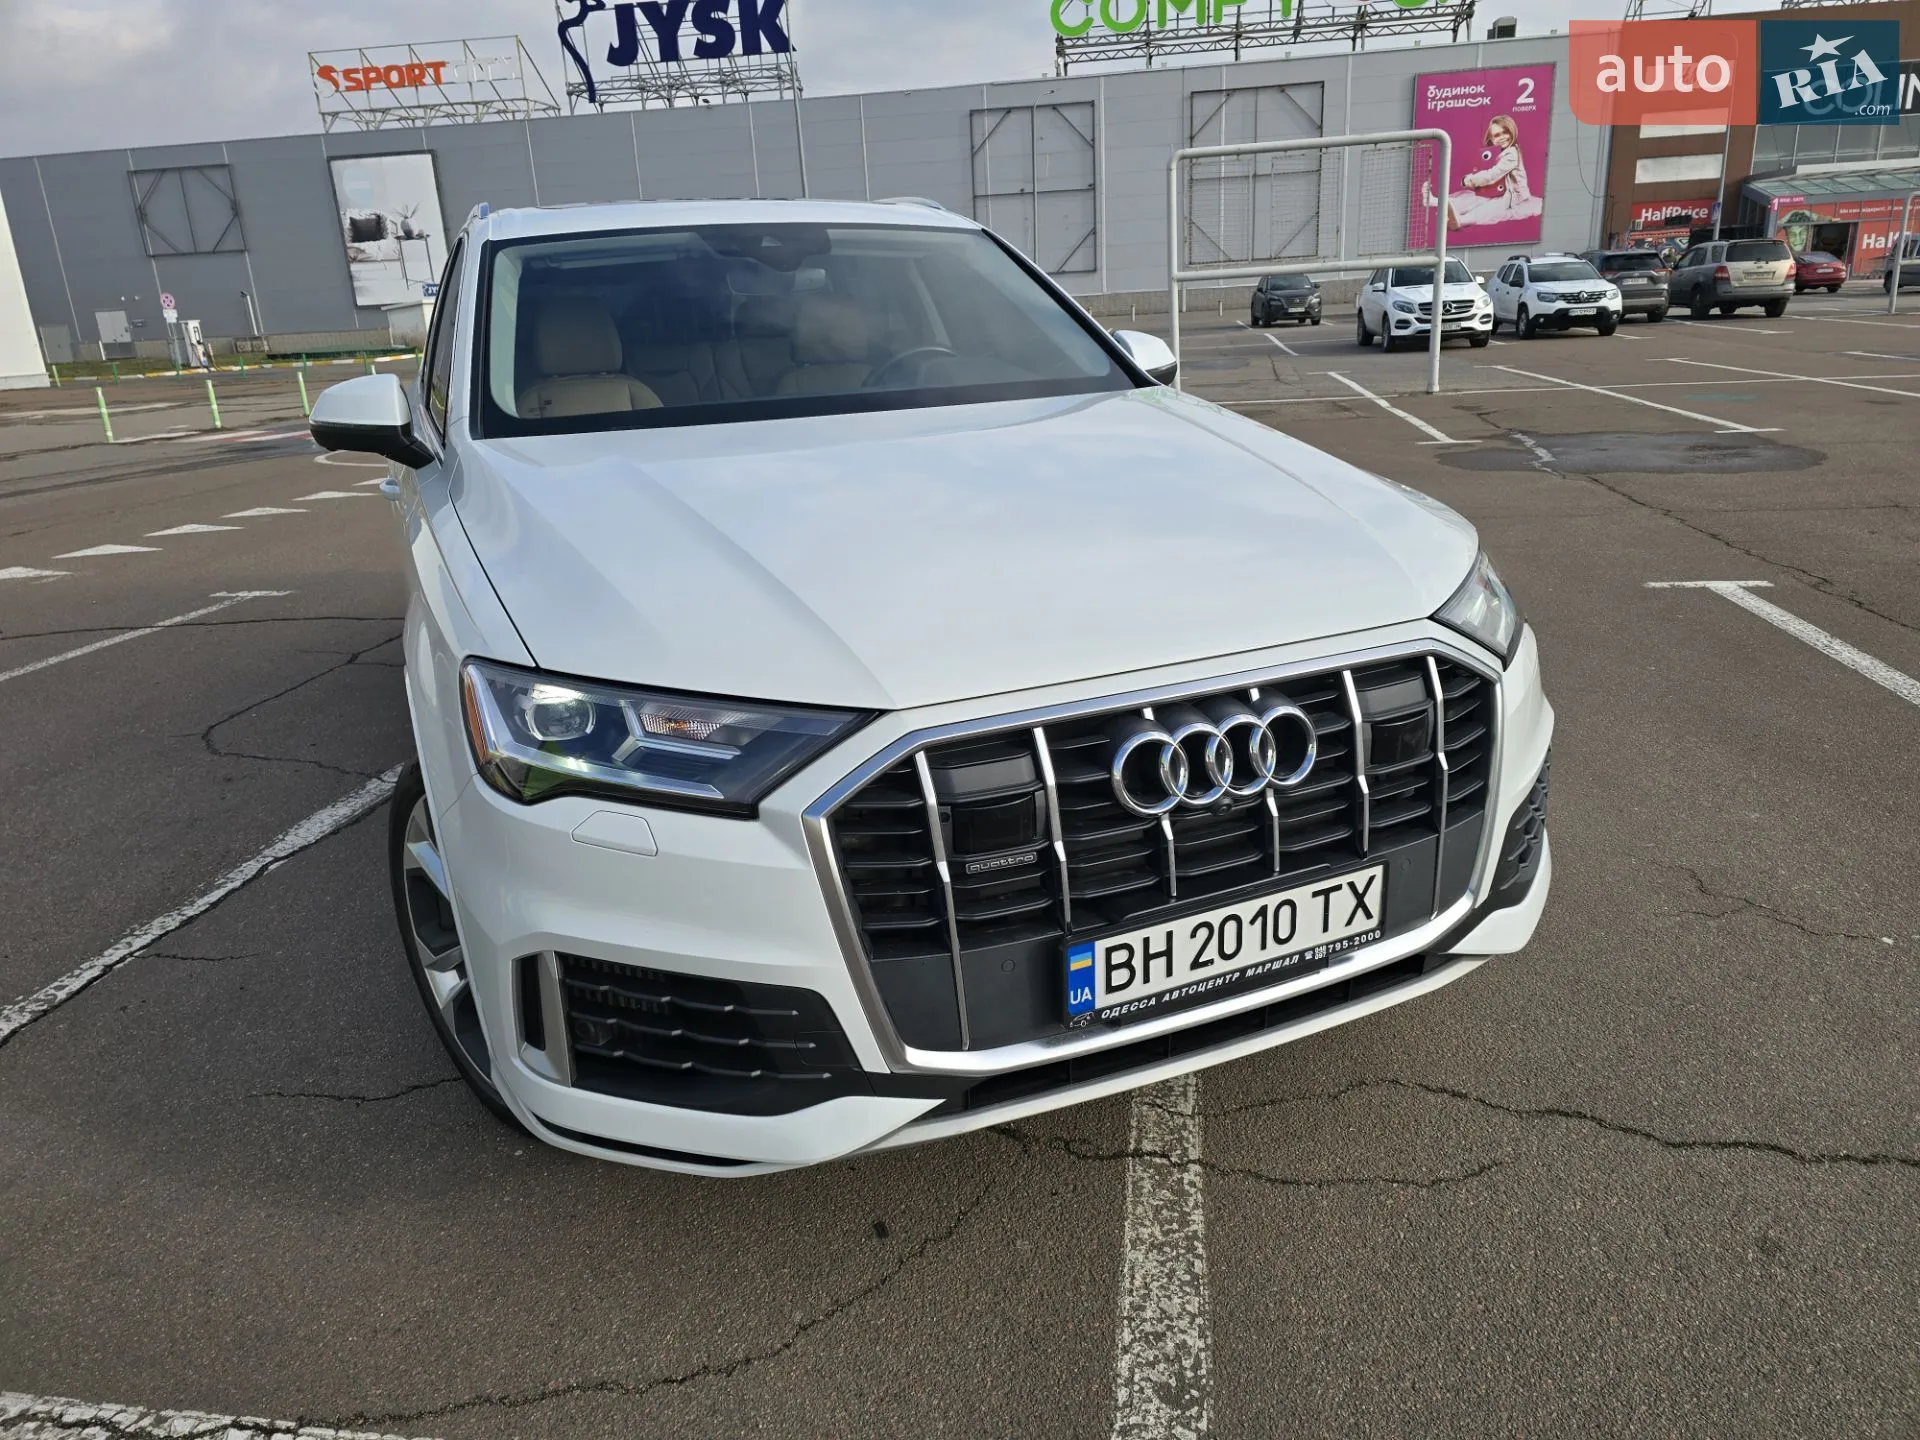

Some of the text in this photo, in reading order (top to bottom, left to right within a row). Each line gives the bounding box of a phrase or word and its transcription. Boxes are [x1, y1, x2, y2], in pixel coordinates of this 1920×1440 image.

[607, 0, 797, 67] JYSK
[342, 61, 448, 92] SPORT
[1427, 85, 1485, 100] будинок
[1516, 77, 1535, 104] 2
[1427, 97, 1491, 112] іграшок
[1641, 206, 1709, 222] HalfPrice
[970, 855, 1034, 872] quattro
[1105, 874, 1377, 995] BH 2010 TX
[1328, 930, 1381, 953] 795-2000
[1070, 987, 1092, 1005] UA
[1101, 954, 1300, 1019] ОДЕССА АВТОЦЕНТР МАРШАЛ
